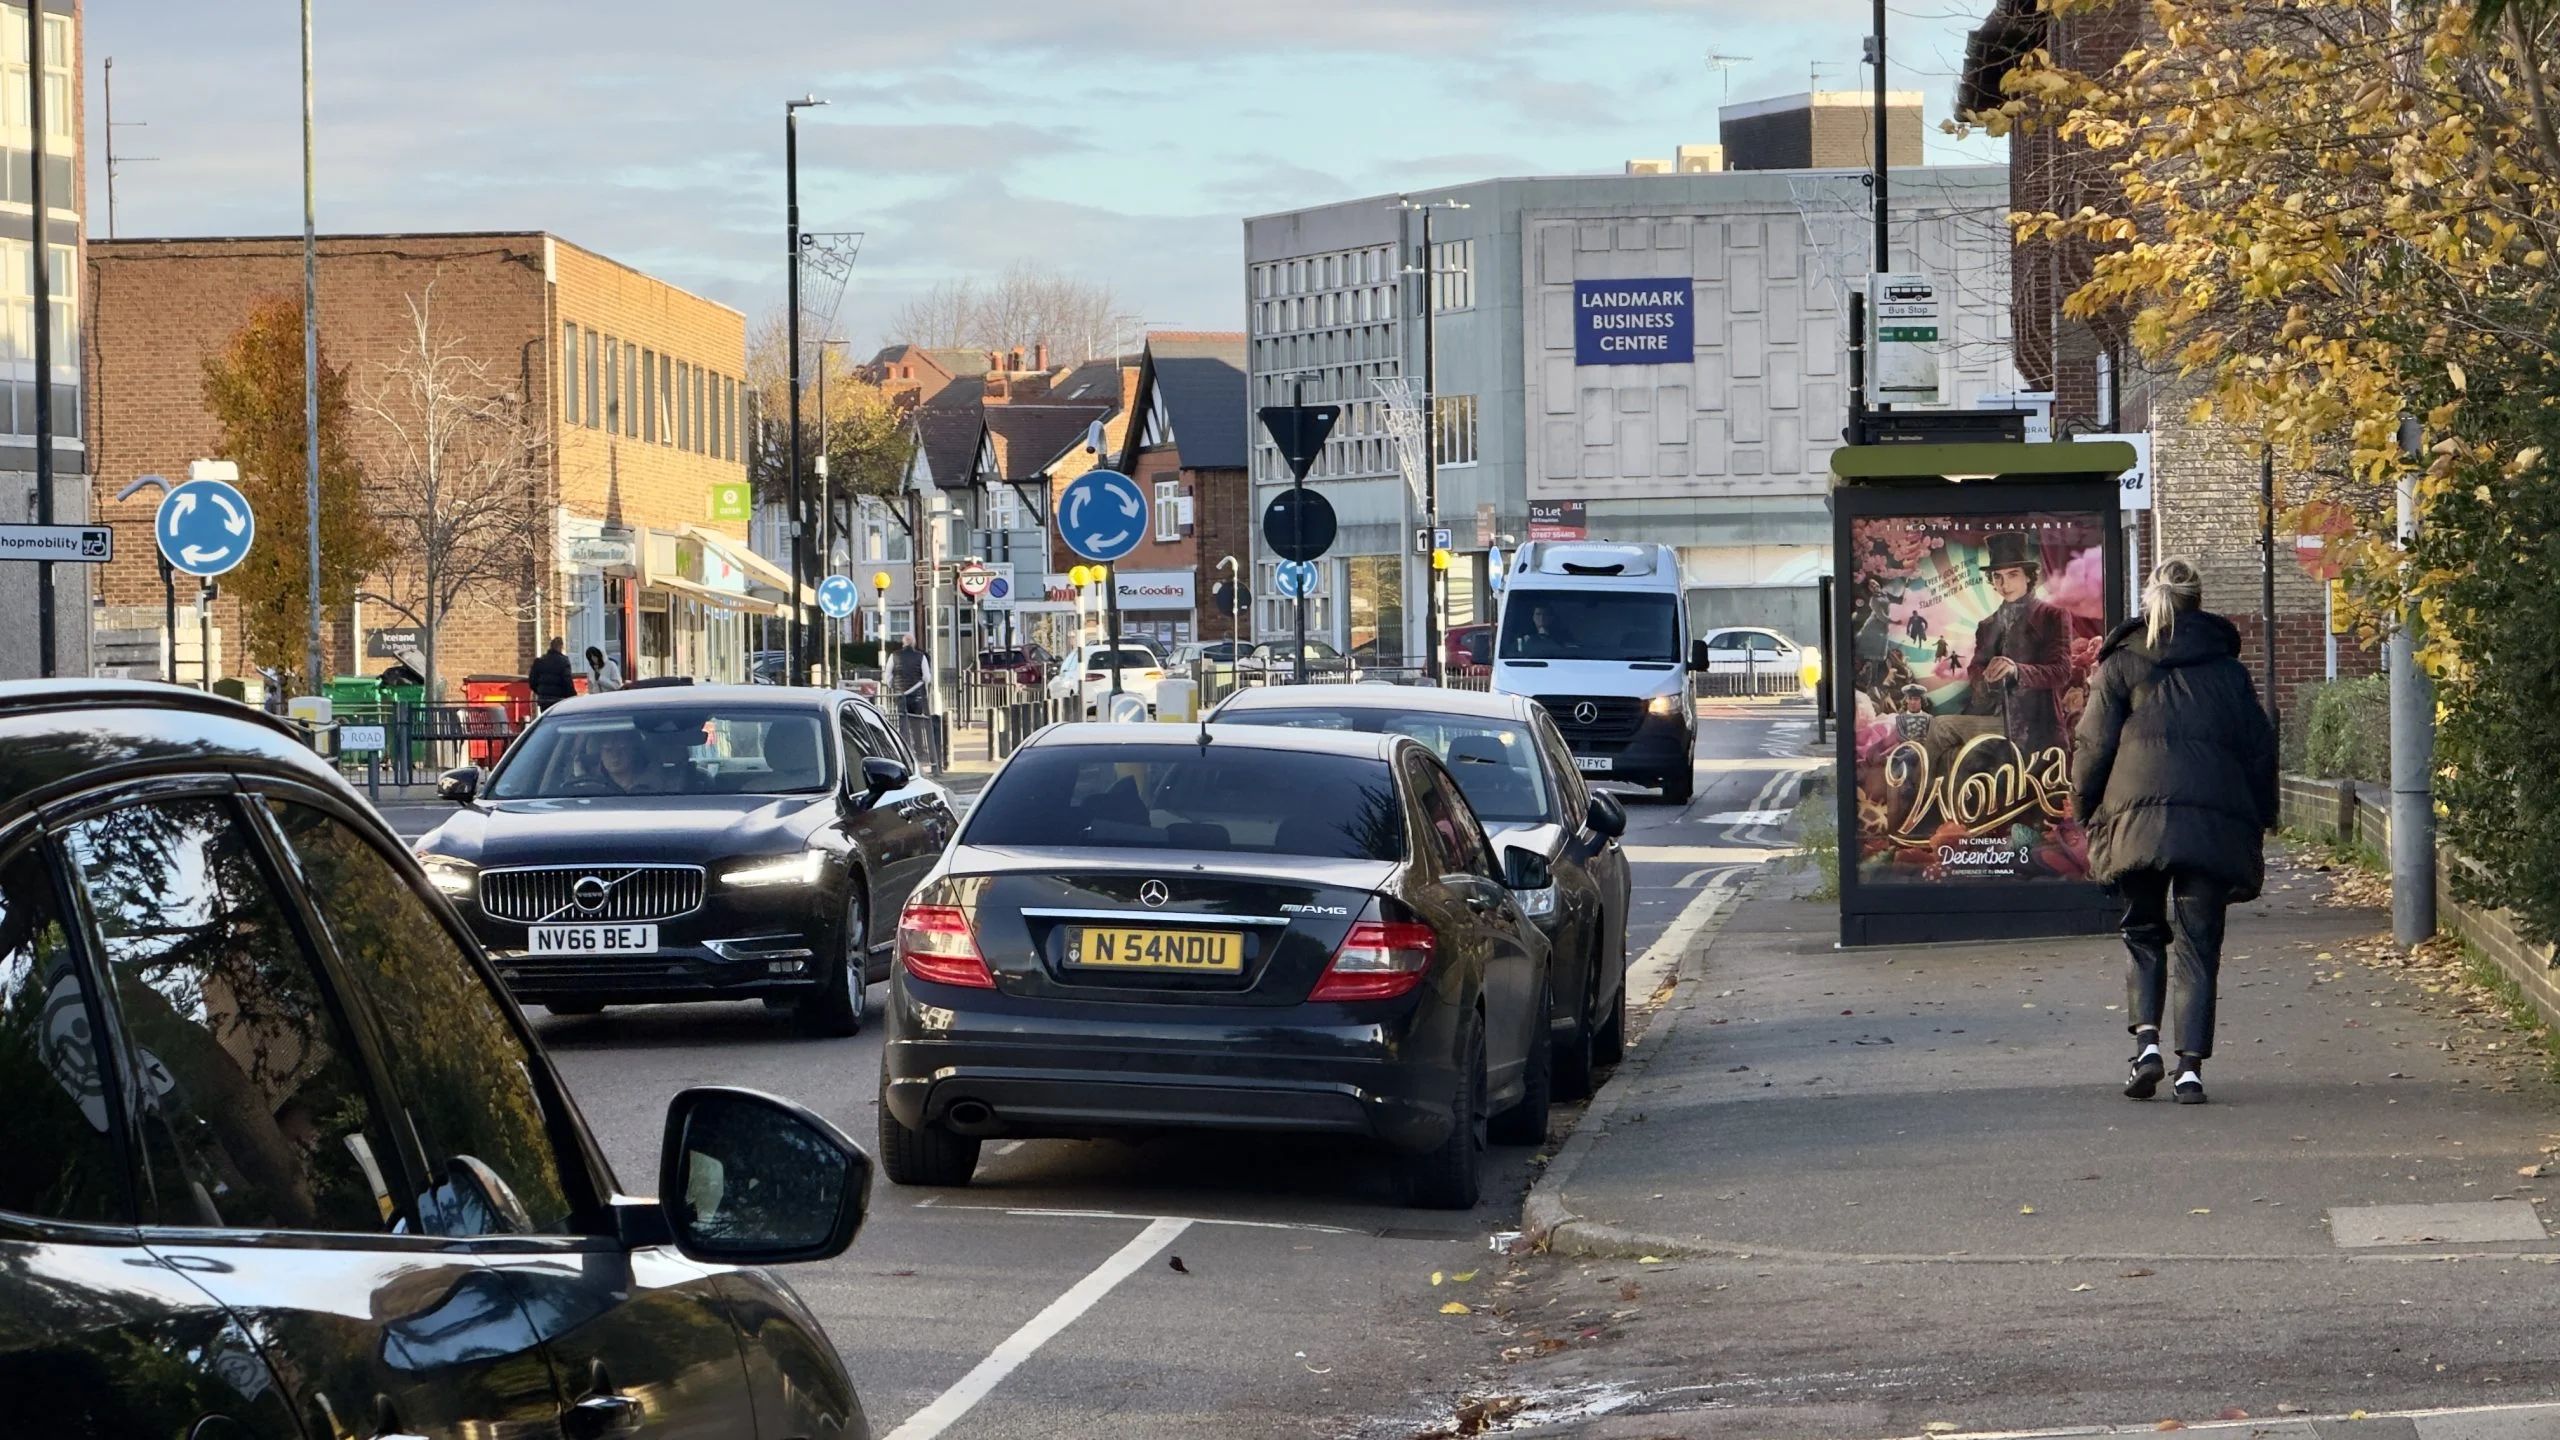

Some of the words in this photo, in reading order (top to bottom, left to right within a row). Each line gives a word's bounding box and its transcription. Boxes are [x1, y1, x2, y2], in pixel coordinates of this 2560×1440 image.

[1582, 291, 1684, 308] LANDMARK
[1888, 306, 1905, 314] Bus
[1907, 305, 1928, 315] Stop
[1593, 313, 1675, 329] BUSINESS
[1600, 335, 1668, 351] CENTRE
[1531, 507, 1544, 517] To
[1546, 507, 1561, 517] Let
[1886, 521, 1970, 531] TIMOTHÉE
[1984, 521, 2073, 530] CHALAMET
[0, 536, 78, 550] hopmobility
[1435, 532, 1446, 548] P
[1139, 584, 1184, 597] Gooding
[1918, 595, 1943, 609] STARTED
[382, 632, 416, 642] Iceland
[351, 732, 382, 742] ROAD
[1587, 759, 1607, 769] FYC
[1885, 734, 2073, 845] Wonka
[1969, 837, 2007, 845] CINEMAS
[1938, 845, 2015, 865] December
[2019, 846, 2029, 864] 8
[1301, 905, 1348, 915] AMG
[538, 929, 596, 950] NV66
[603, 928, 647, 949] BEJ
[1095, 933, 1115, 961] N
[1124, 934, 1226, 965] 54NDU
